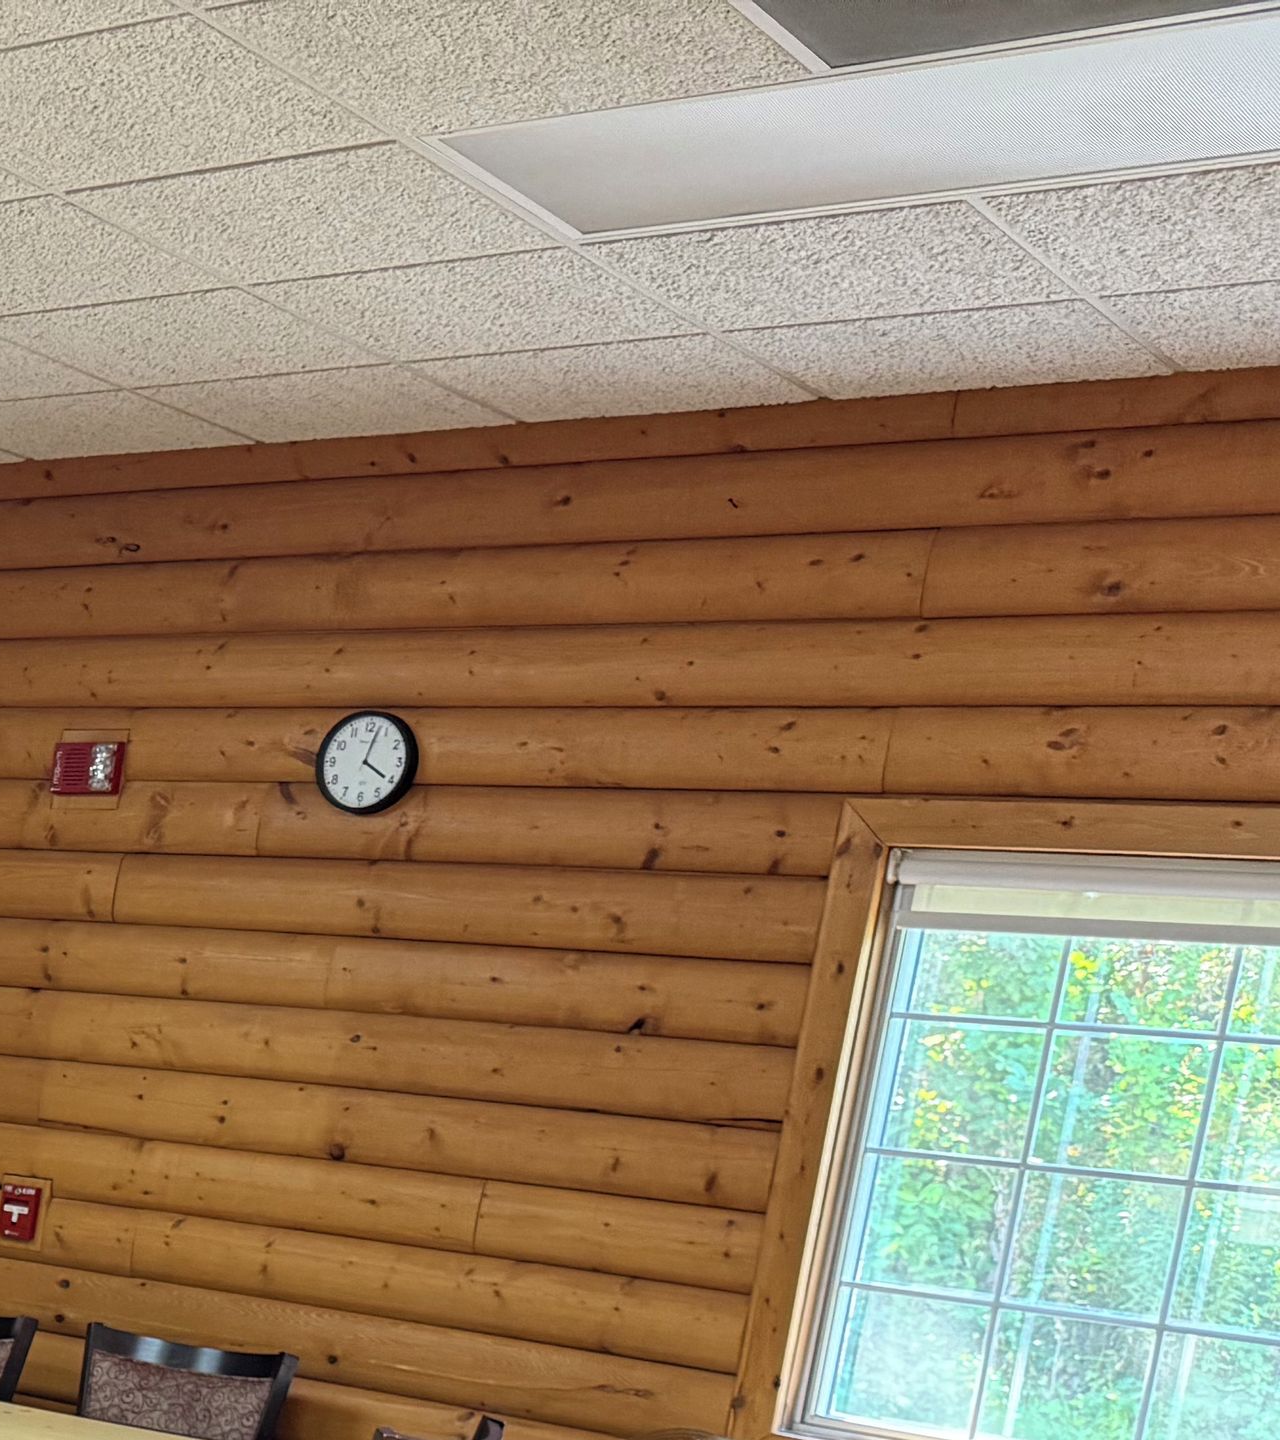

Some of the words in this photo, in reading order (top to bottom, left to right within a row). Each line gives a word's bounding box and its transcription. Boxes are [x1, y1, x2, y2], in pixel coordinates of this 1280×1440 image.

[350, 727, 358, 738] 11
[365, 722, 376, 732] 12
[336, 740, 347, 751] 10
[393, 739, 401, 750] 2
[329, 756, 336, 767] 9
[395, 757, 403, 768] 3
[331, 774, 338, 785] 8
[387, 774, 395, 784] 4
[342, 786, 349, 797] 7
[356, 791, 364, 801] 6
[374, 787, 381, 798] 5
